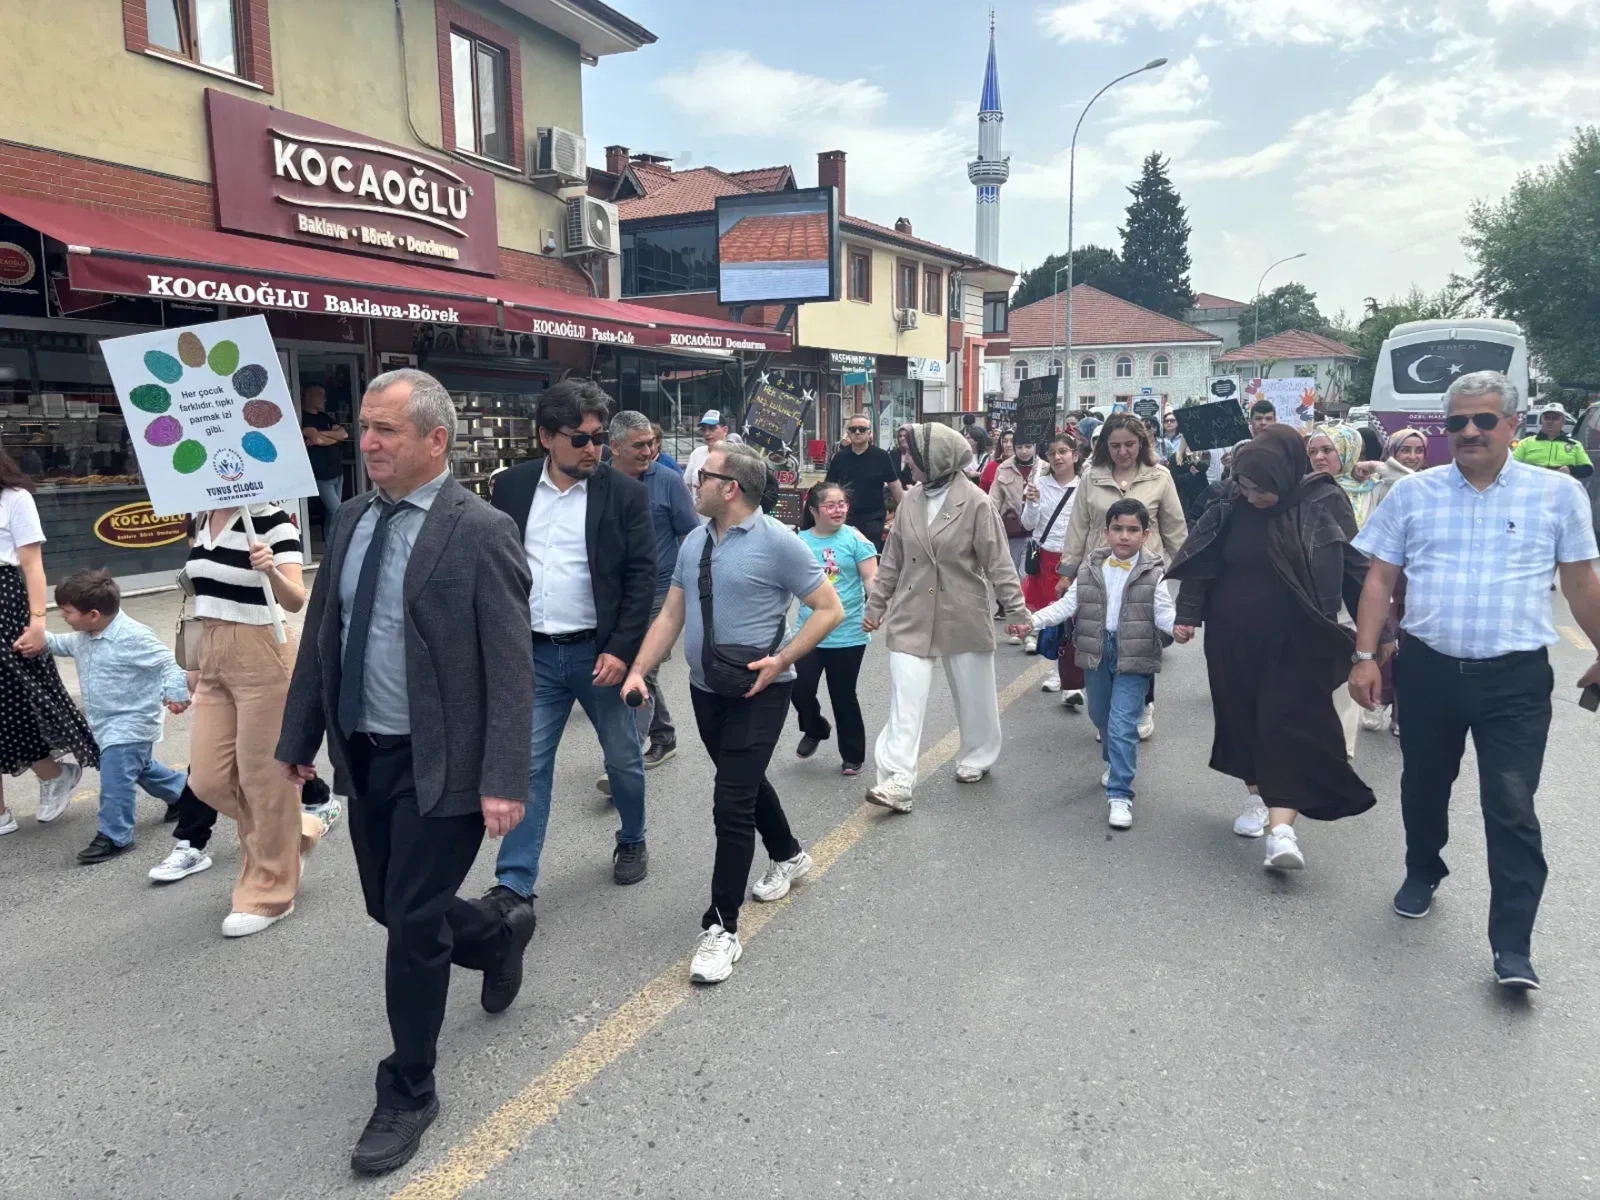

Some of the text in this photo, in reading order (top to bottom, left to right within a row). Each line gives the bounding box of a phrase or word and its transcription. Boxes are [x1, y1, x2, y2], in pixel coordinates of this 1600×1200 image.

[272, 138, 468, 220] KOCAOĞLU
[297, 213, 460, 261] Baklava Börek Dondurma
[147, 275, 460, 323] KOCAOĞLU Baklava-Börek
[533, 319, 635, 344] KOCAOĞLU Pasta-Cafe
[670, 333, 767, 350] KOCAOĞLU Dondurma
[181, 385, 224, 399] Her çocuk
[215, 398, 234, 408] tıpkı
[189, 411, 232, 425] parmak izi
[205, 425, 224, 436] gibi.
[206, 480, 264, 497] YUNUS ÇİLOĞLU
